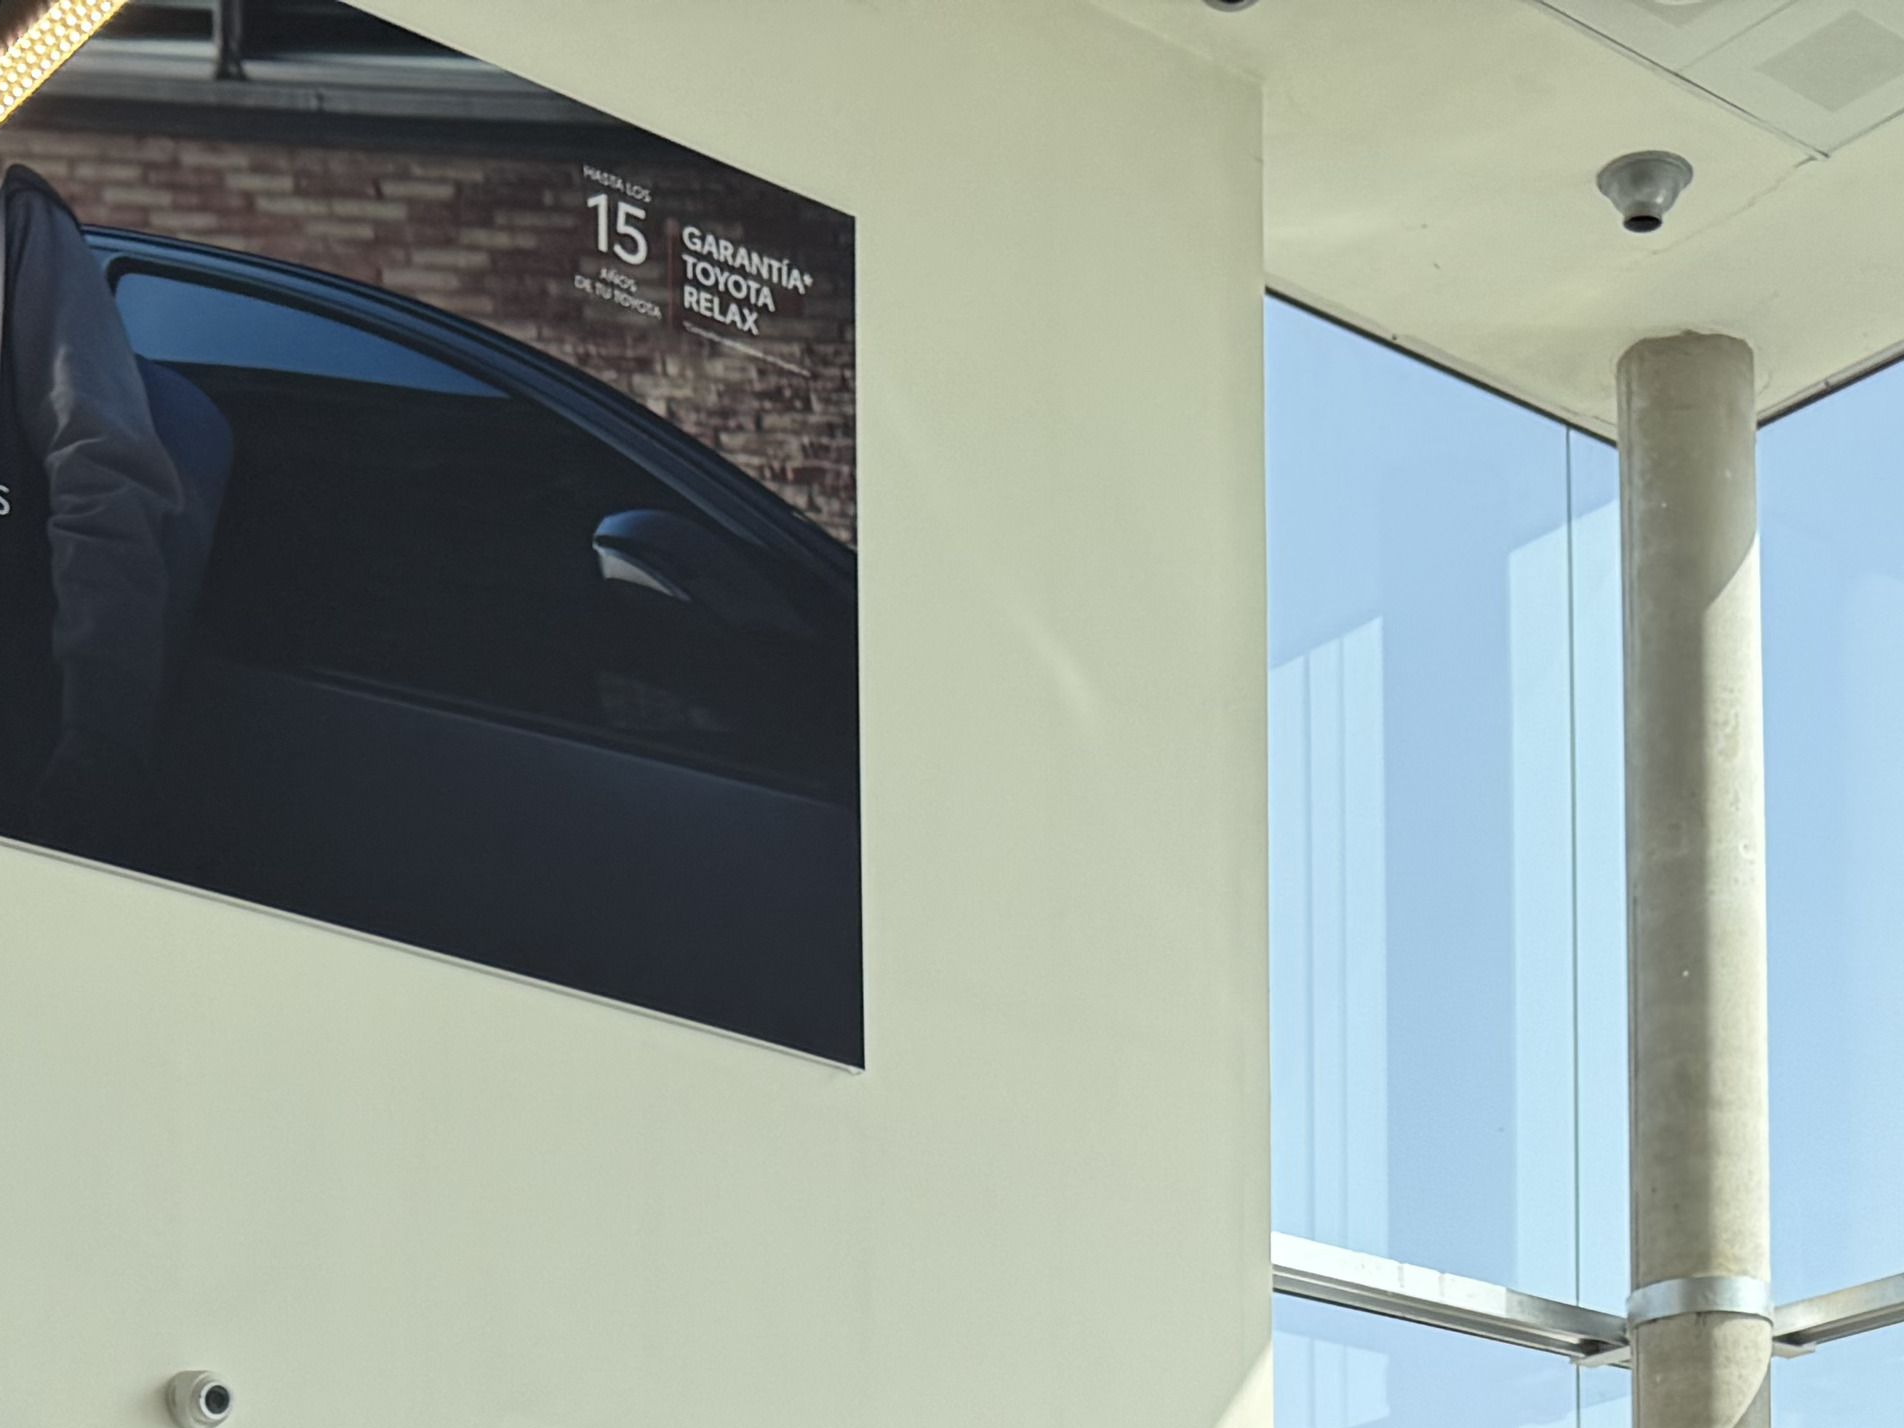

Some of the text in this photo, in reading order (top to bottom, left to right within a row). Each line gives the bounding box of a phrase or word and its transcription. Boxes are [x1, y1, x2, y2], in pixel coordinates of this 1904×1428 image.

[587, 193, 647, 265] 15
[682, 254, 775, 312] TOYOTA
[684, 285, 759, 336] RELAX
